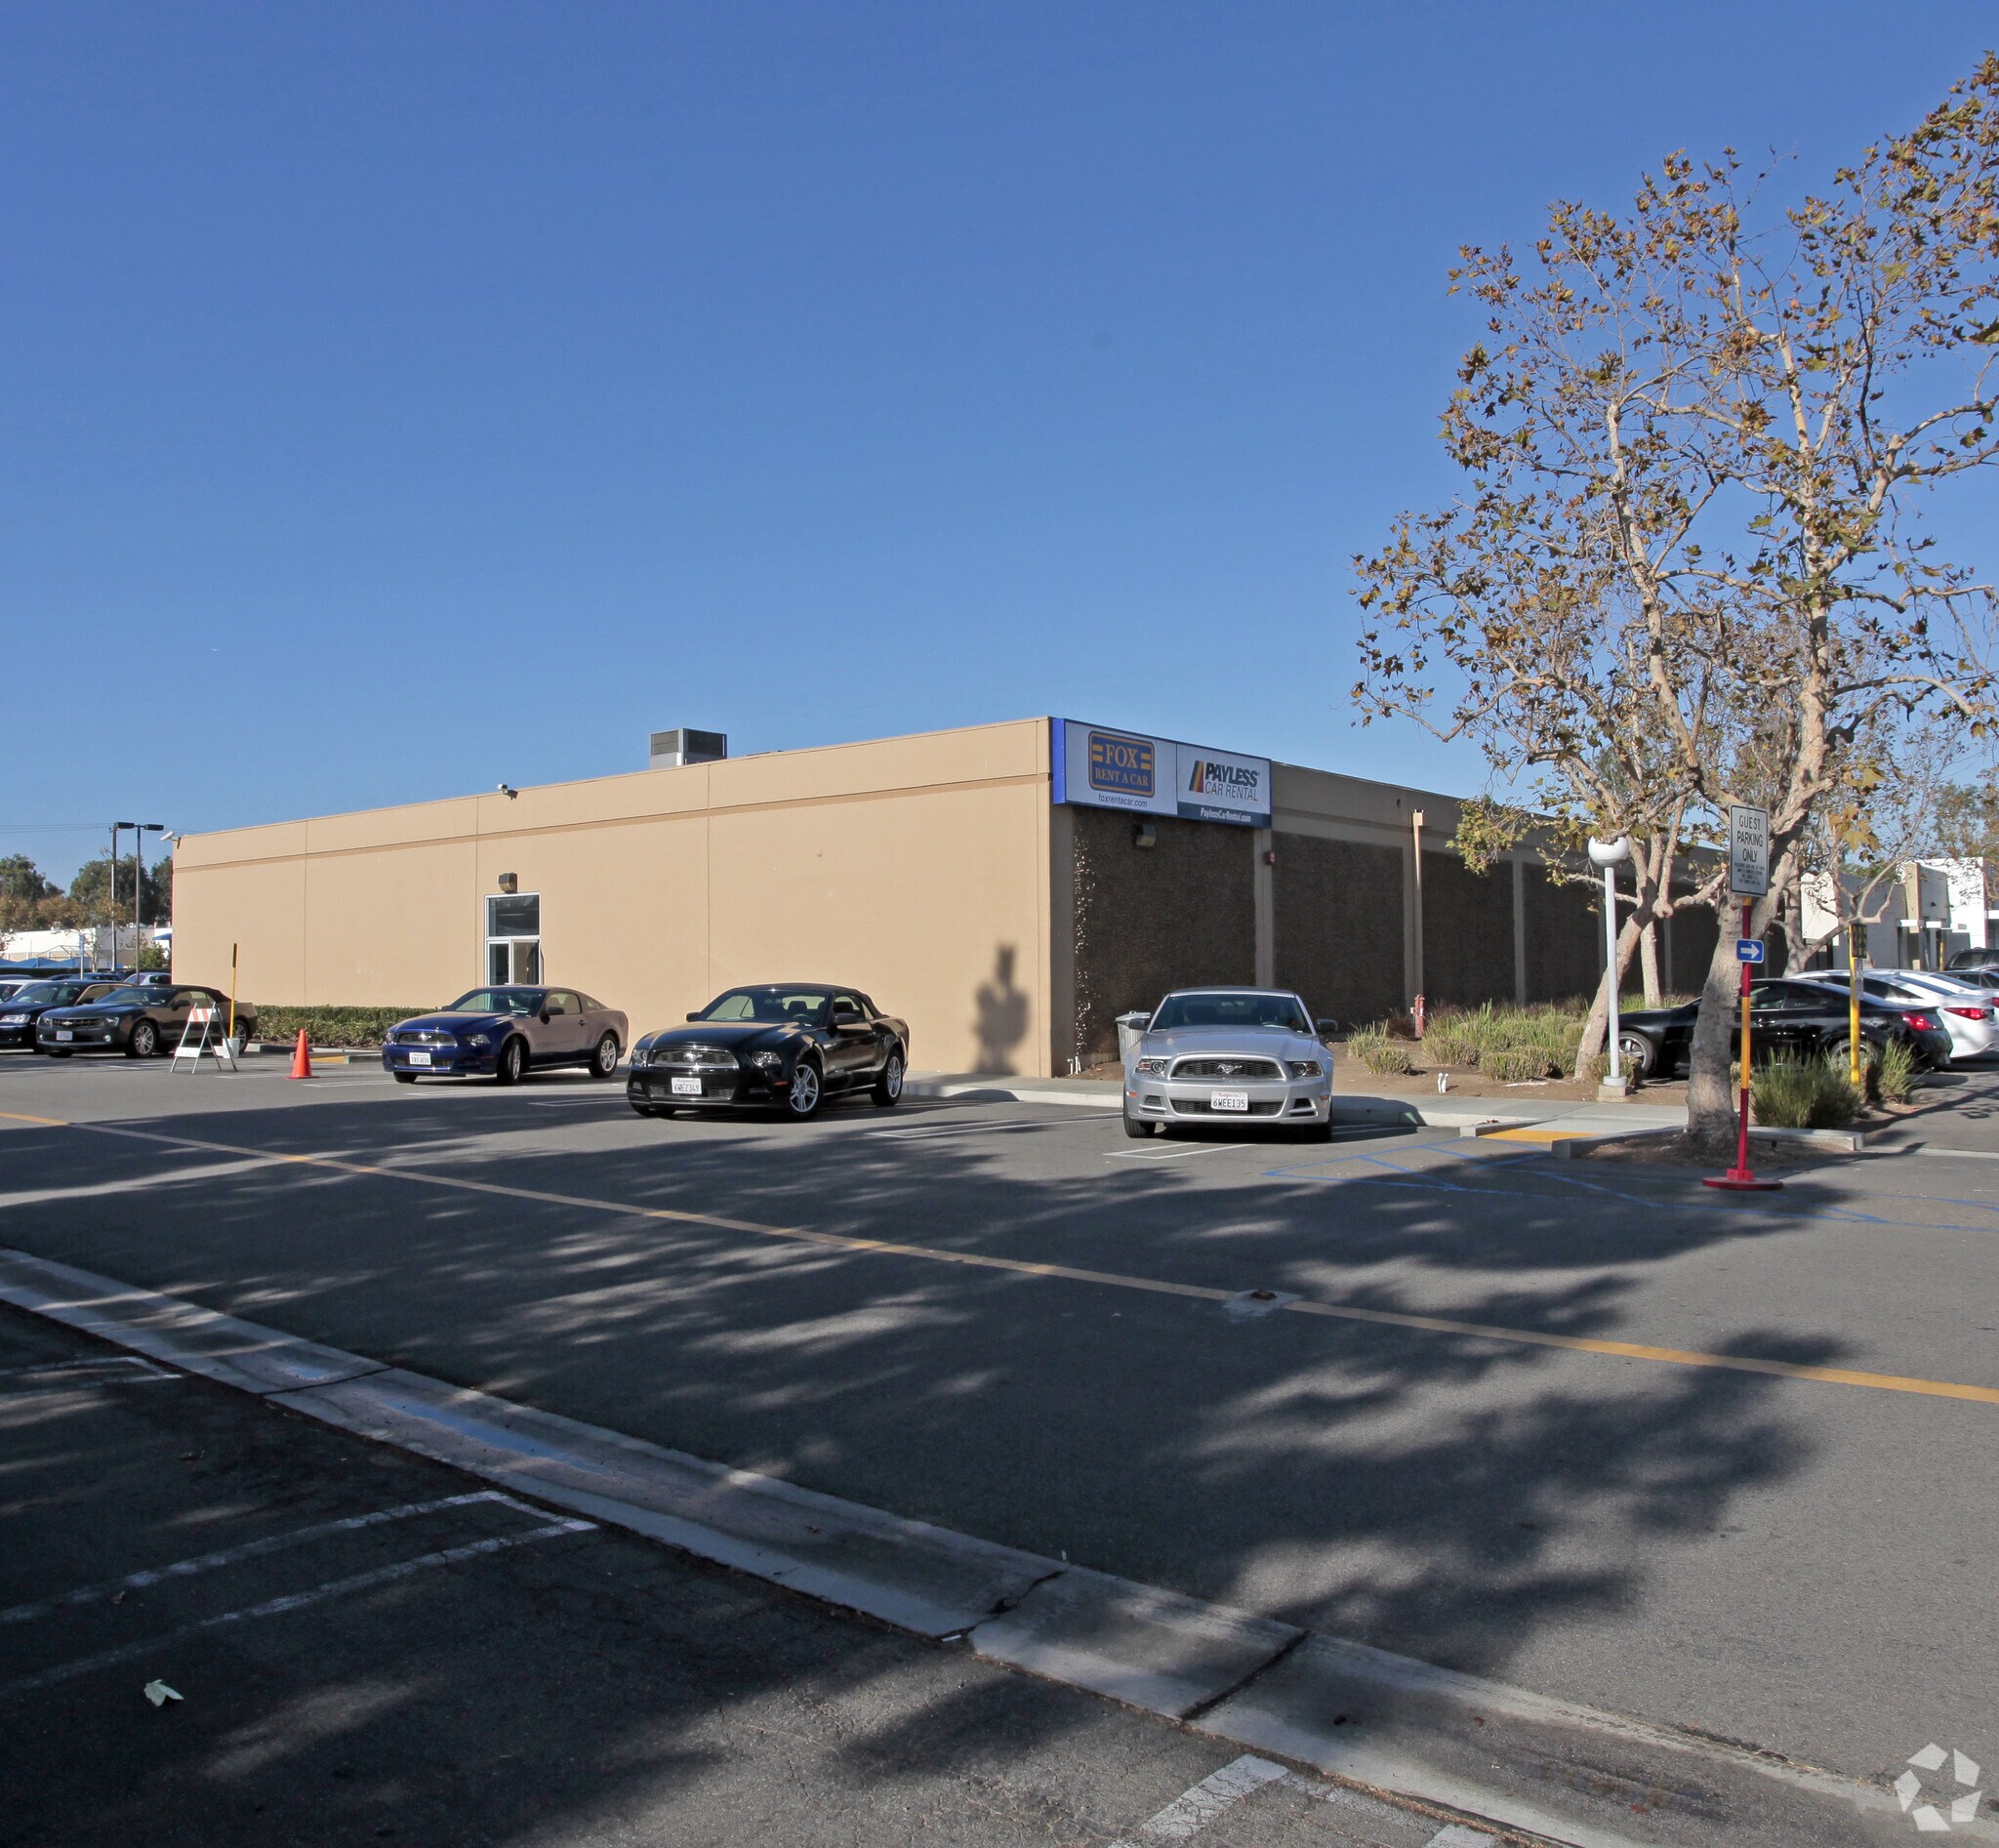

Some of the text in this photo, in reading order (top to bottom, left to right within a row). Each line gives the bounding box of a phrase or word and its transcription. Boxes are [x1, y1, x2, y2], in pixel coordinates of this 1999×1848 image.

[1105, 743, 1138, 769] FOX
[1095, 767, 1148, 787] RENT A CAR
[1205, 761, 1258, 788] PAYLESS
[1204, 781, 1257, 801] CAR RENTAL
[1098, 793, 1148, 807] foxrentacar.com
[1738, 814, 1761, 831] GUEST
[1736, 830, 1763, 847] PARKING
[1742, 847, 1758, 863] ONLY
[1212, 1098, 1245, 1108] 6WEE135
